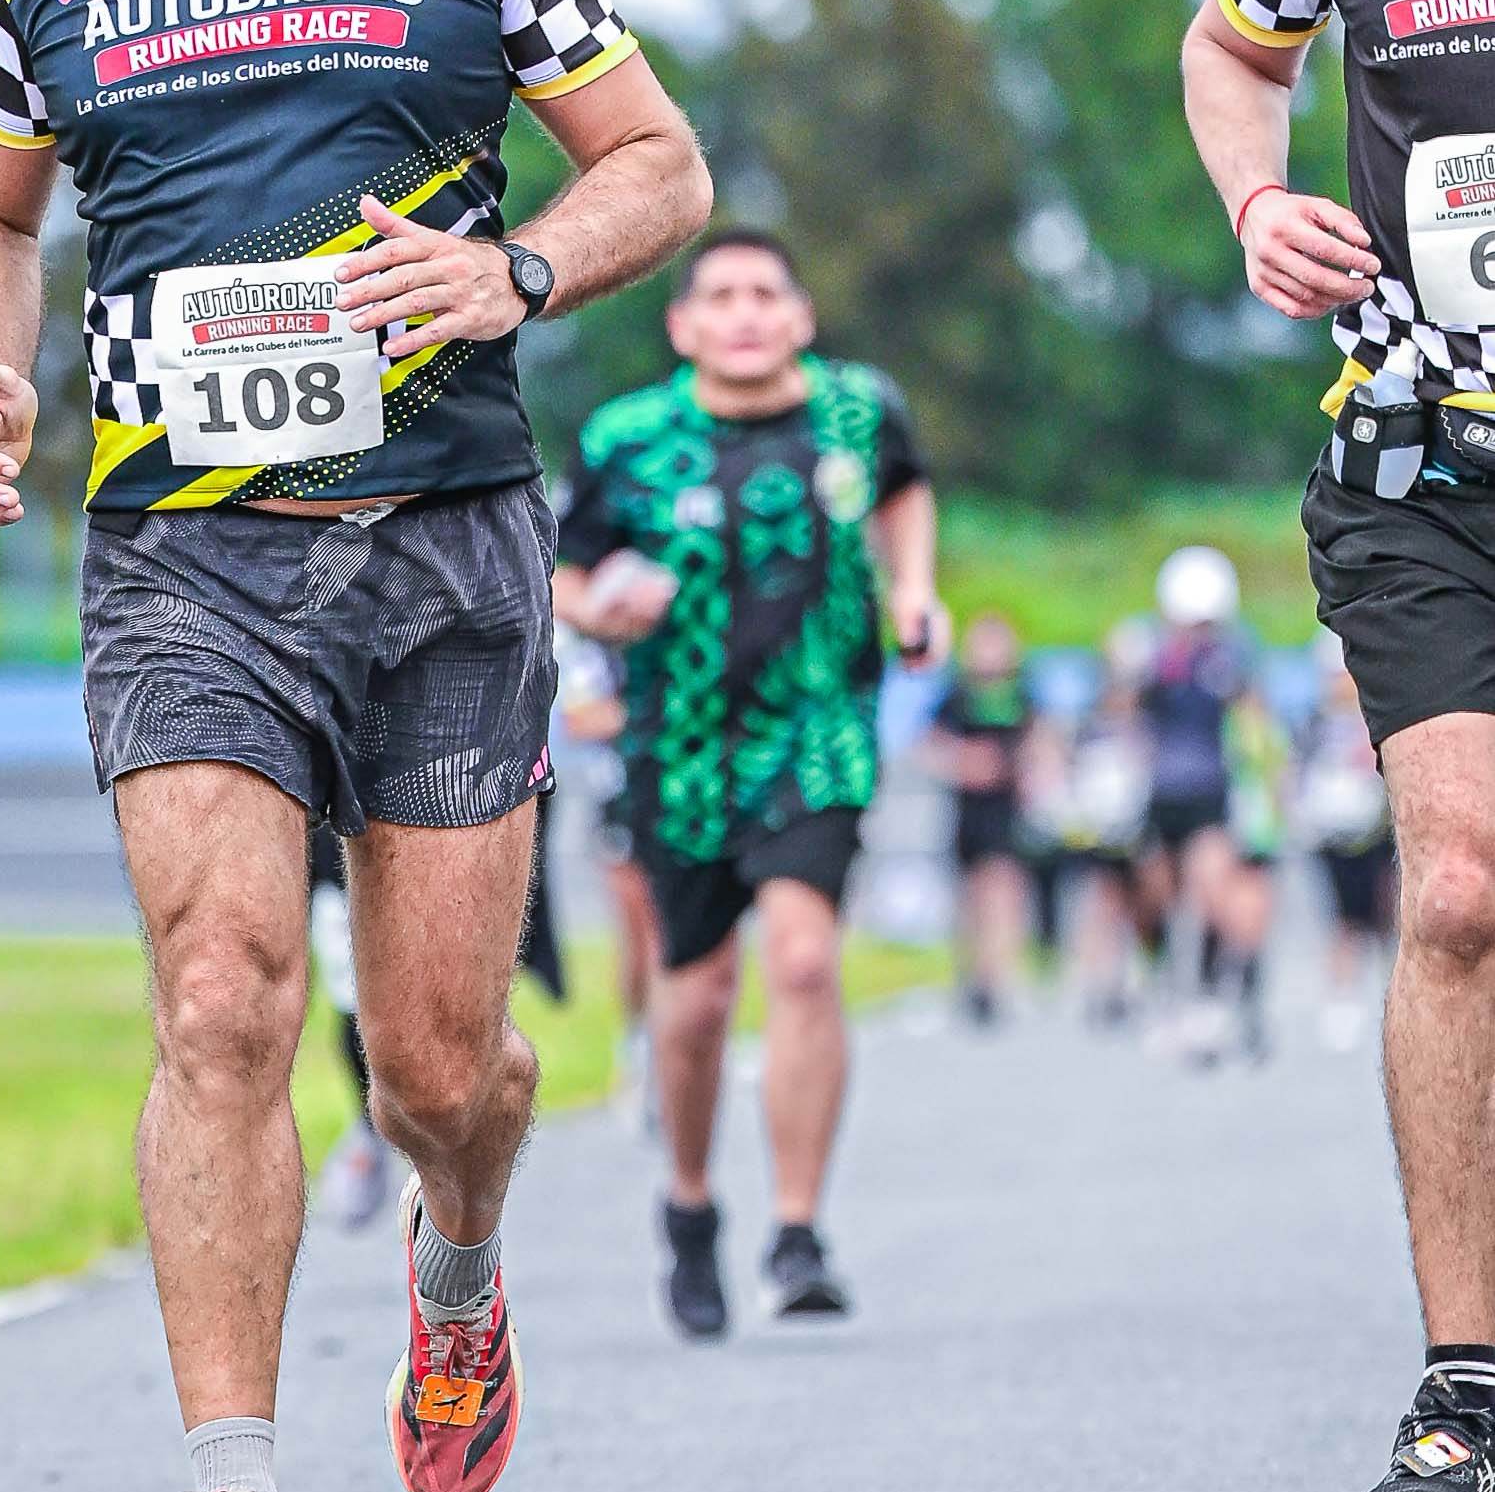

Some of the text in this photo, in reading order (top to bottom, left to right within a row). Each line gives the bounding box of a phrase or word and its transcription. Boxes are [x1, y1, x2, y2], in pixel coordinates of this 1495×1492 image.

[127, 10, 371, 72] RUNNING RACE
[1373, 45, 1388, 62] La
[1388, 40, 1446, 60] Carrera
[1448, 35, 1471, 54] de
[75, 52, 430, 116] La Carrera de los Clubes del Noroeste
[1436, 207, 1492, 221] La Carrera de
[182, 278, 338, 323] AUTÓDROMO
[206, 315, 314, 341] RUNNING RACE
[182, 336, 343, 357] La Carrera de los Clubes del Noroeste
[193, 362, 345, 433] 108
